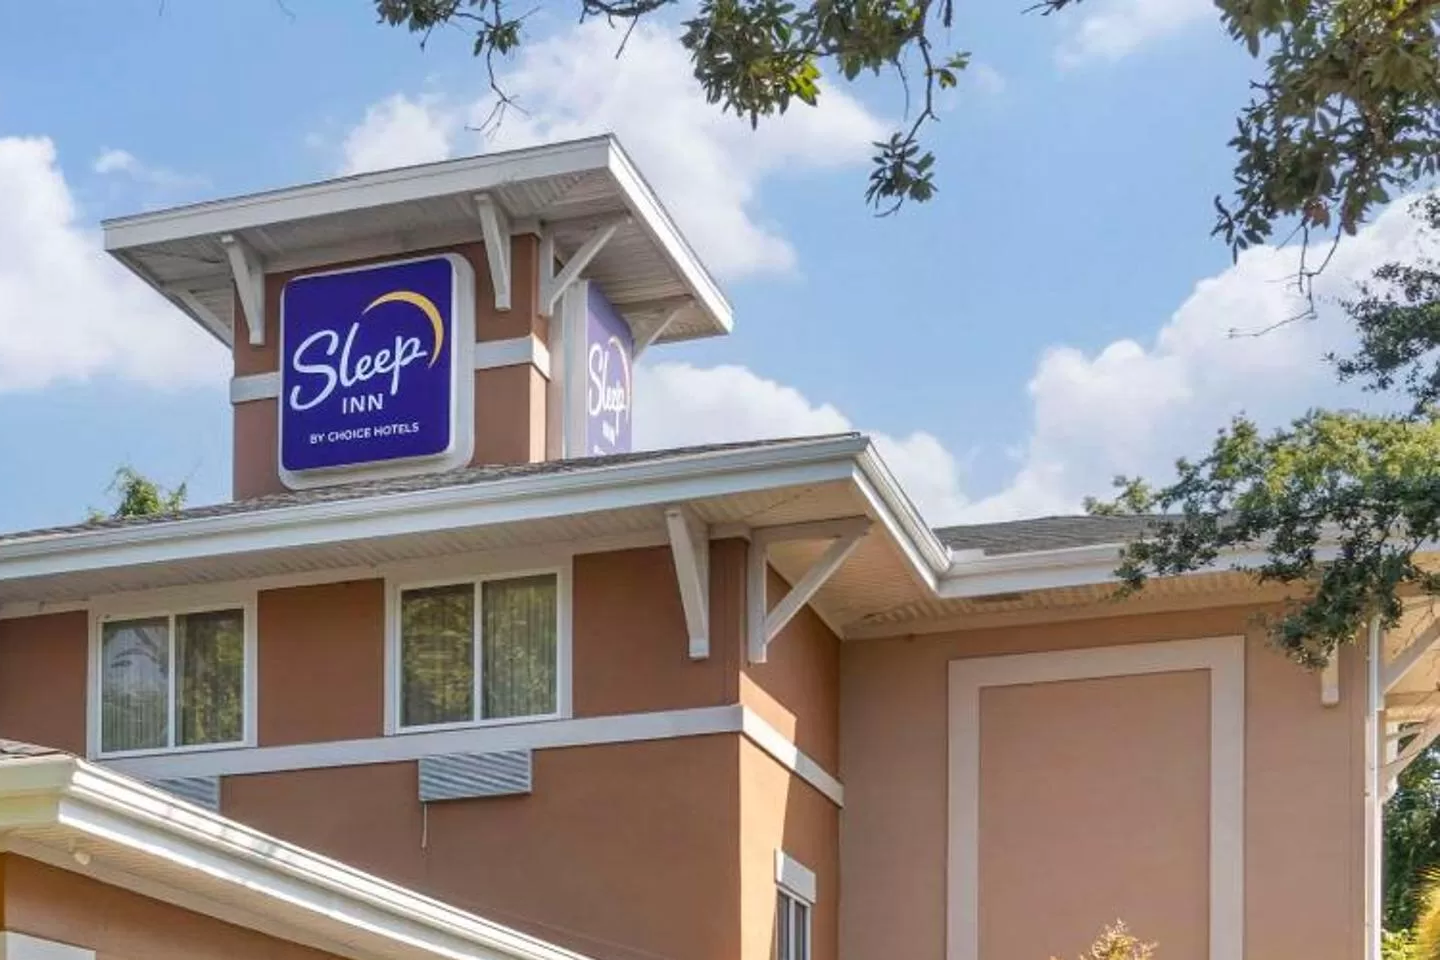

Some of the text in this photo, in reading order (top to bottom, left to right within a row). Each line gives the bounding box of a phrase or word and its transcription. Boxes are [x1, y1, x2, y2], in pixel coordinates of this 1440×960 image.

[289, 322, 428, 410] Sleep
[588, 342, 627, 437] Sleep
[342, 393, 384, 414] INN
[310, 422, 420, 445] BY CHOICE HOTELS
